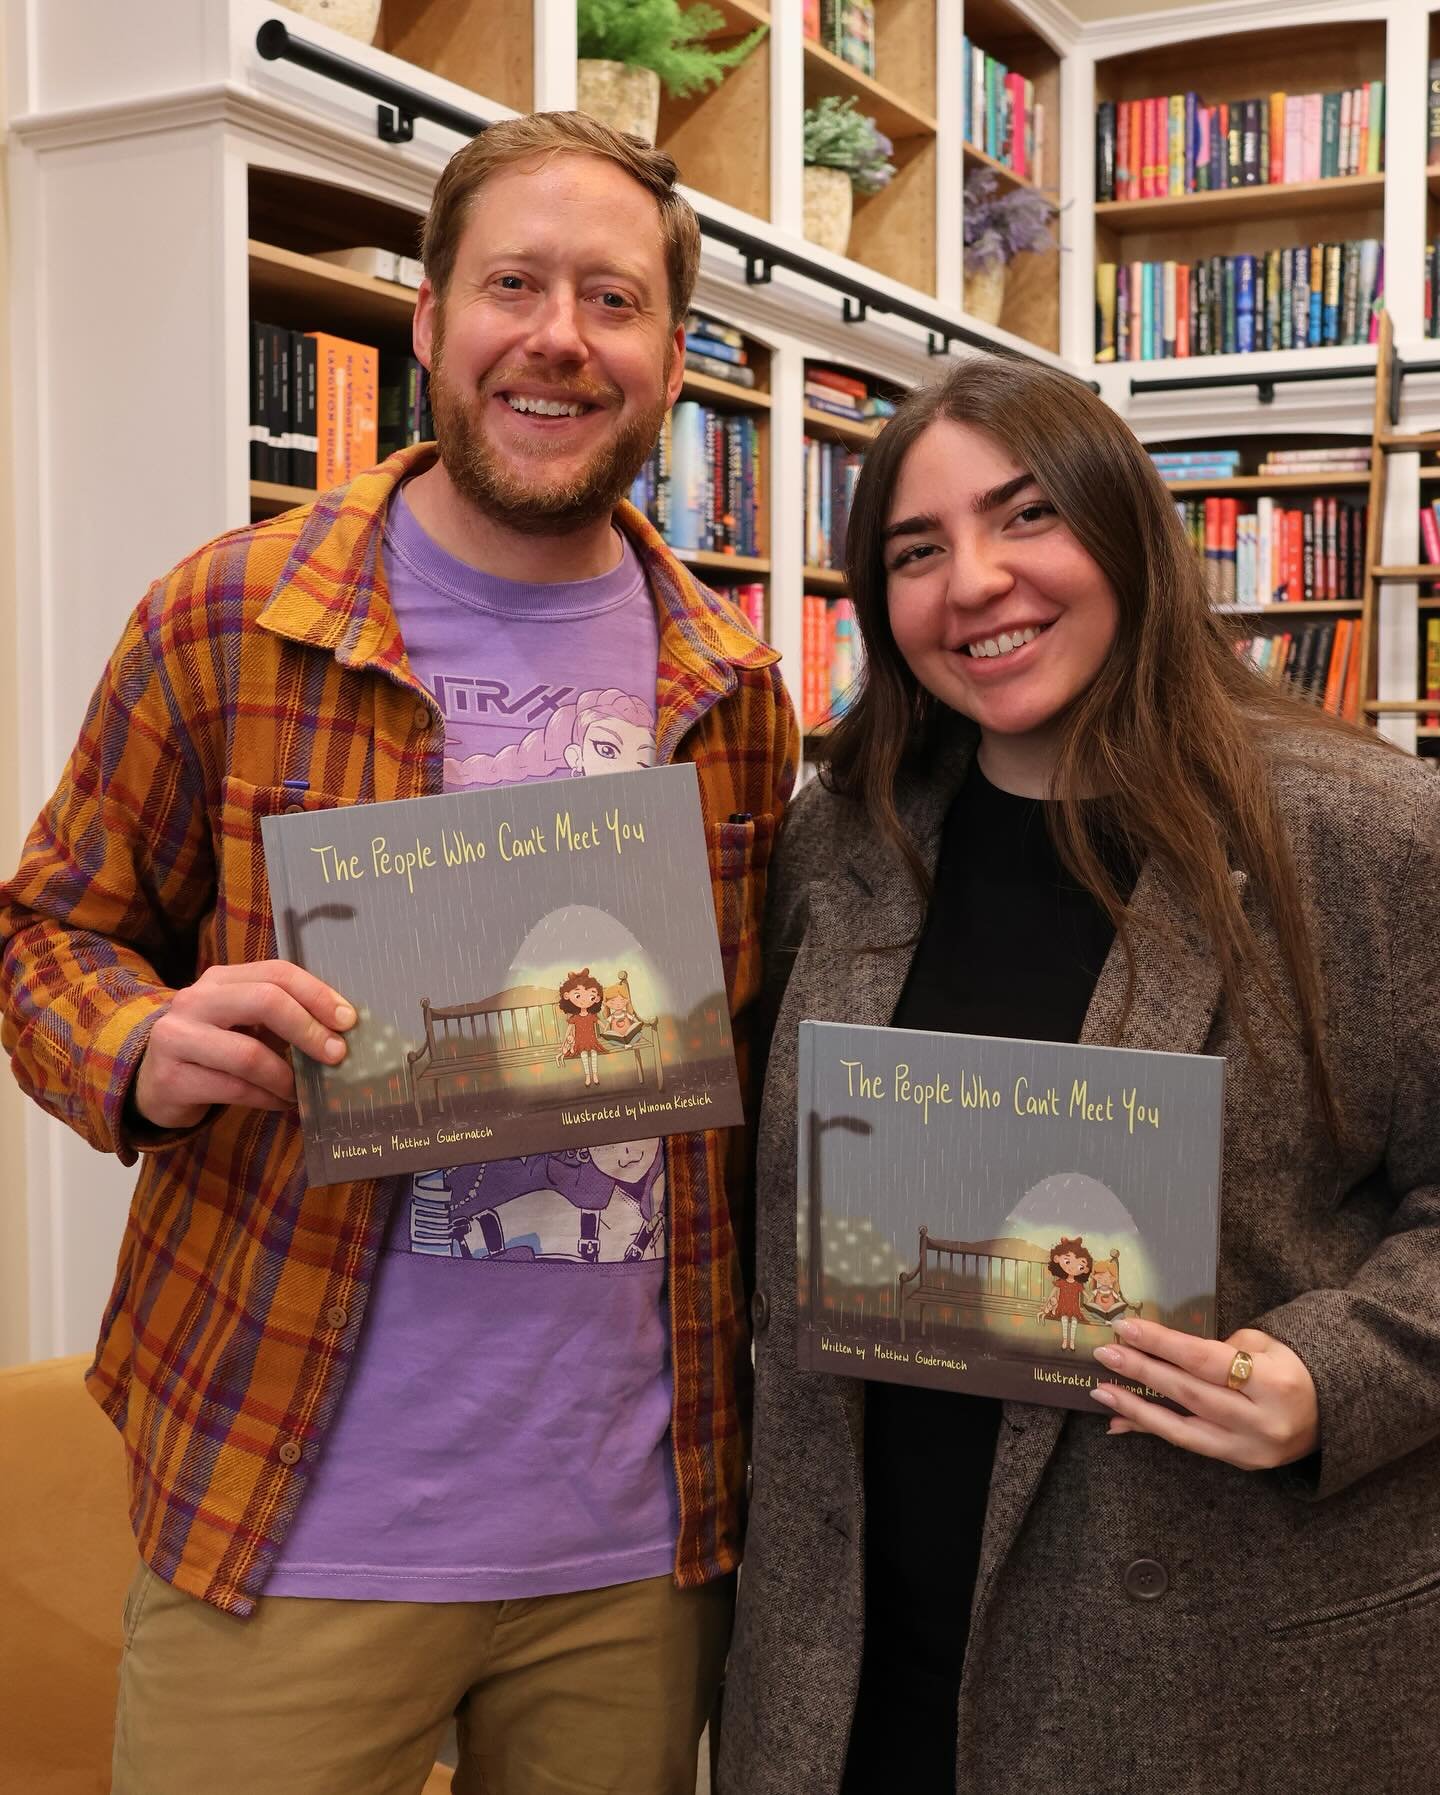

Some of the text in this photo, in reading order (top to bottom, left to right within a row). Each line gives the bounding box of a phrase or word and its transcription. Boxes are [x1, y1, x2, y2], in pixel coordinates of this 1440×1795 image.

[310, 807, 645, 894] The People Who Can't Meet You
[561, 1092, 713, 1126] Illustrated by Winona Kieslich
[839, 1059, 1159, 1134] The People Who Can't Meet You
[332, 1126, 493, 1159] Written by Matthew Gudernatch
[821, 1336, 968, 1371] Written by Matthew Gudernatch
[1033, 1367, 1091, 1387] Illustrated
